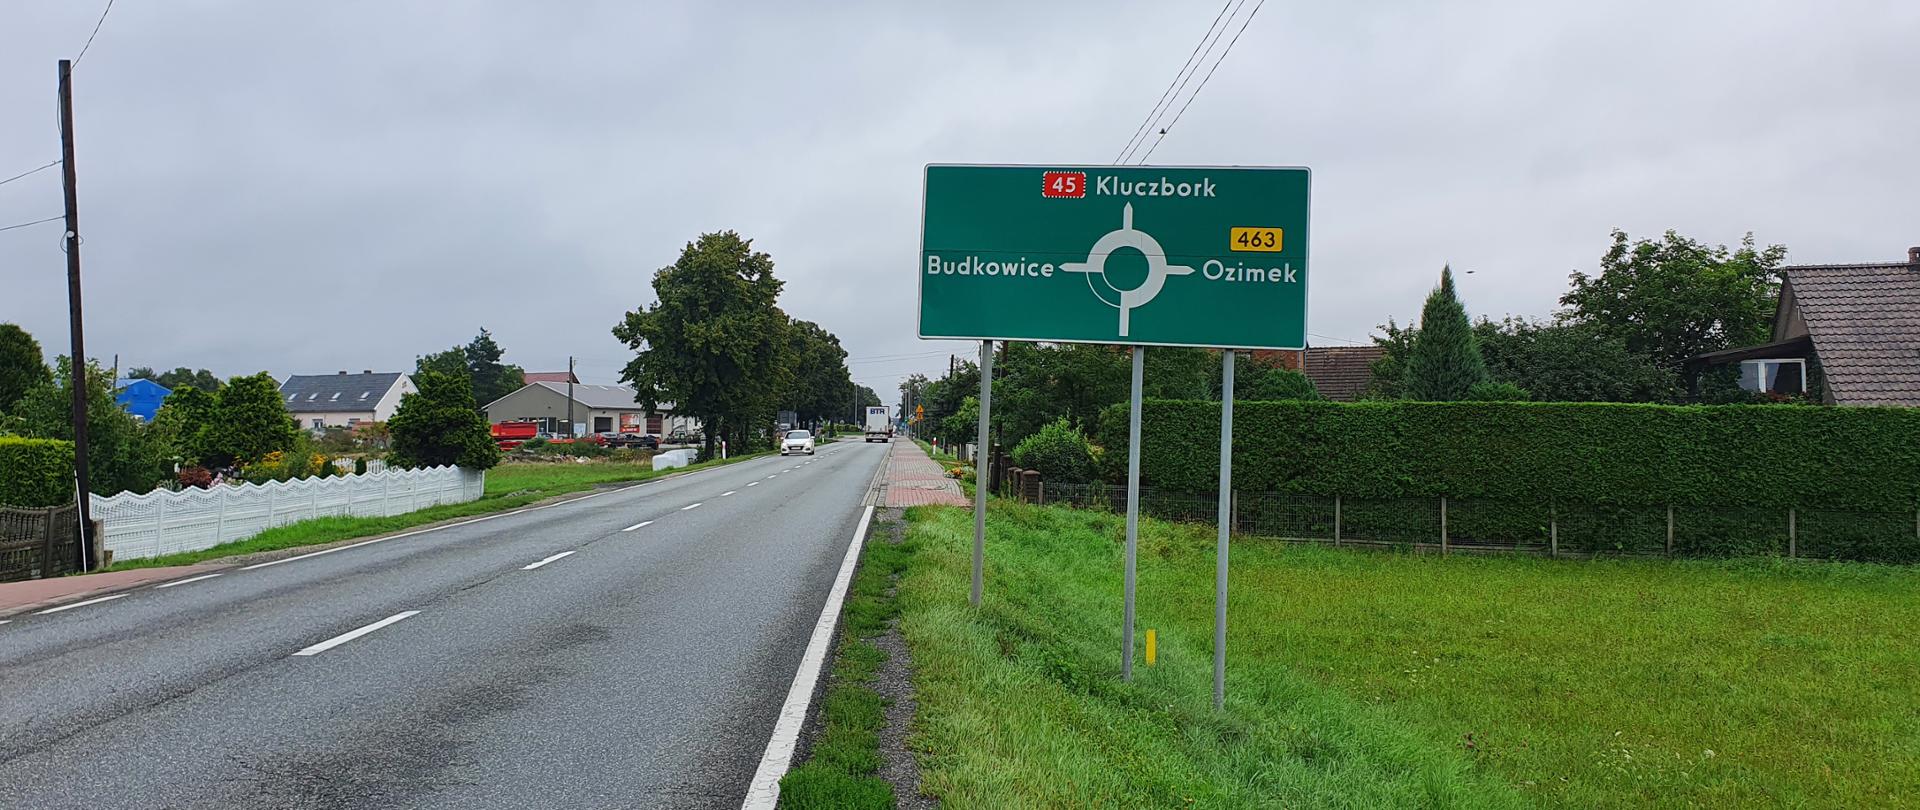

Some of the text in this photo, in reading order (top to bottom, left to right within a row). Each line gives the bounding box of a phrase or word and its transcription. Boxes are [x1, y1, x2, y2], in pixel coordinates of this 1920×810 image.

[1052, 177, 1076, 193] 45
[1096, 176, 1217, 197] Kluczbork
[1237, 231, 1275, 248] 463
[927, 255, 1054, 277] Budkowice
[1202, 259, 1297, 283] Ozimek
